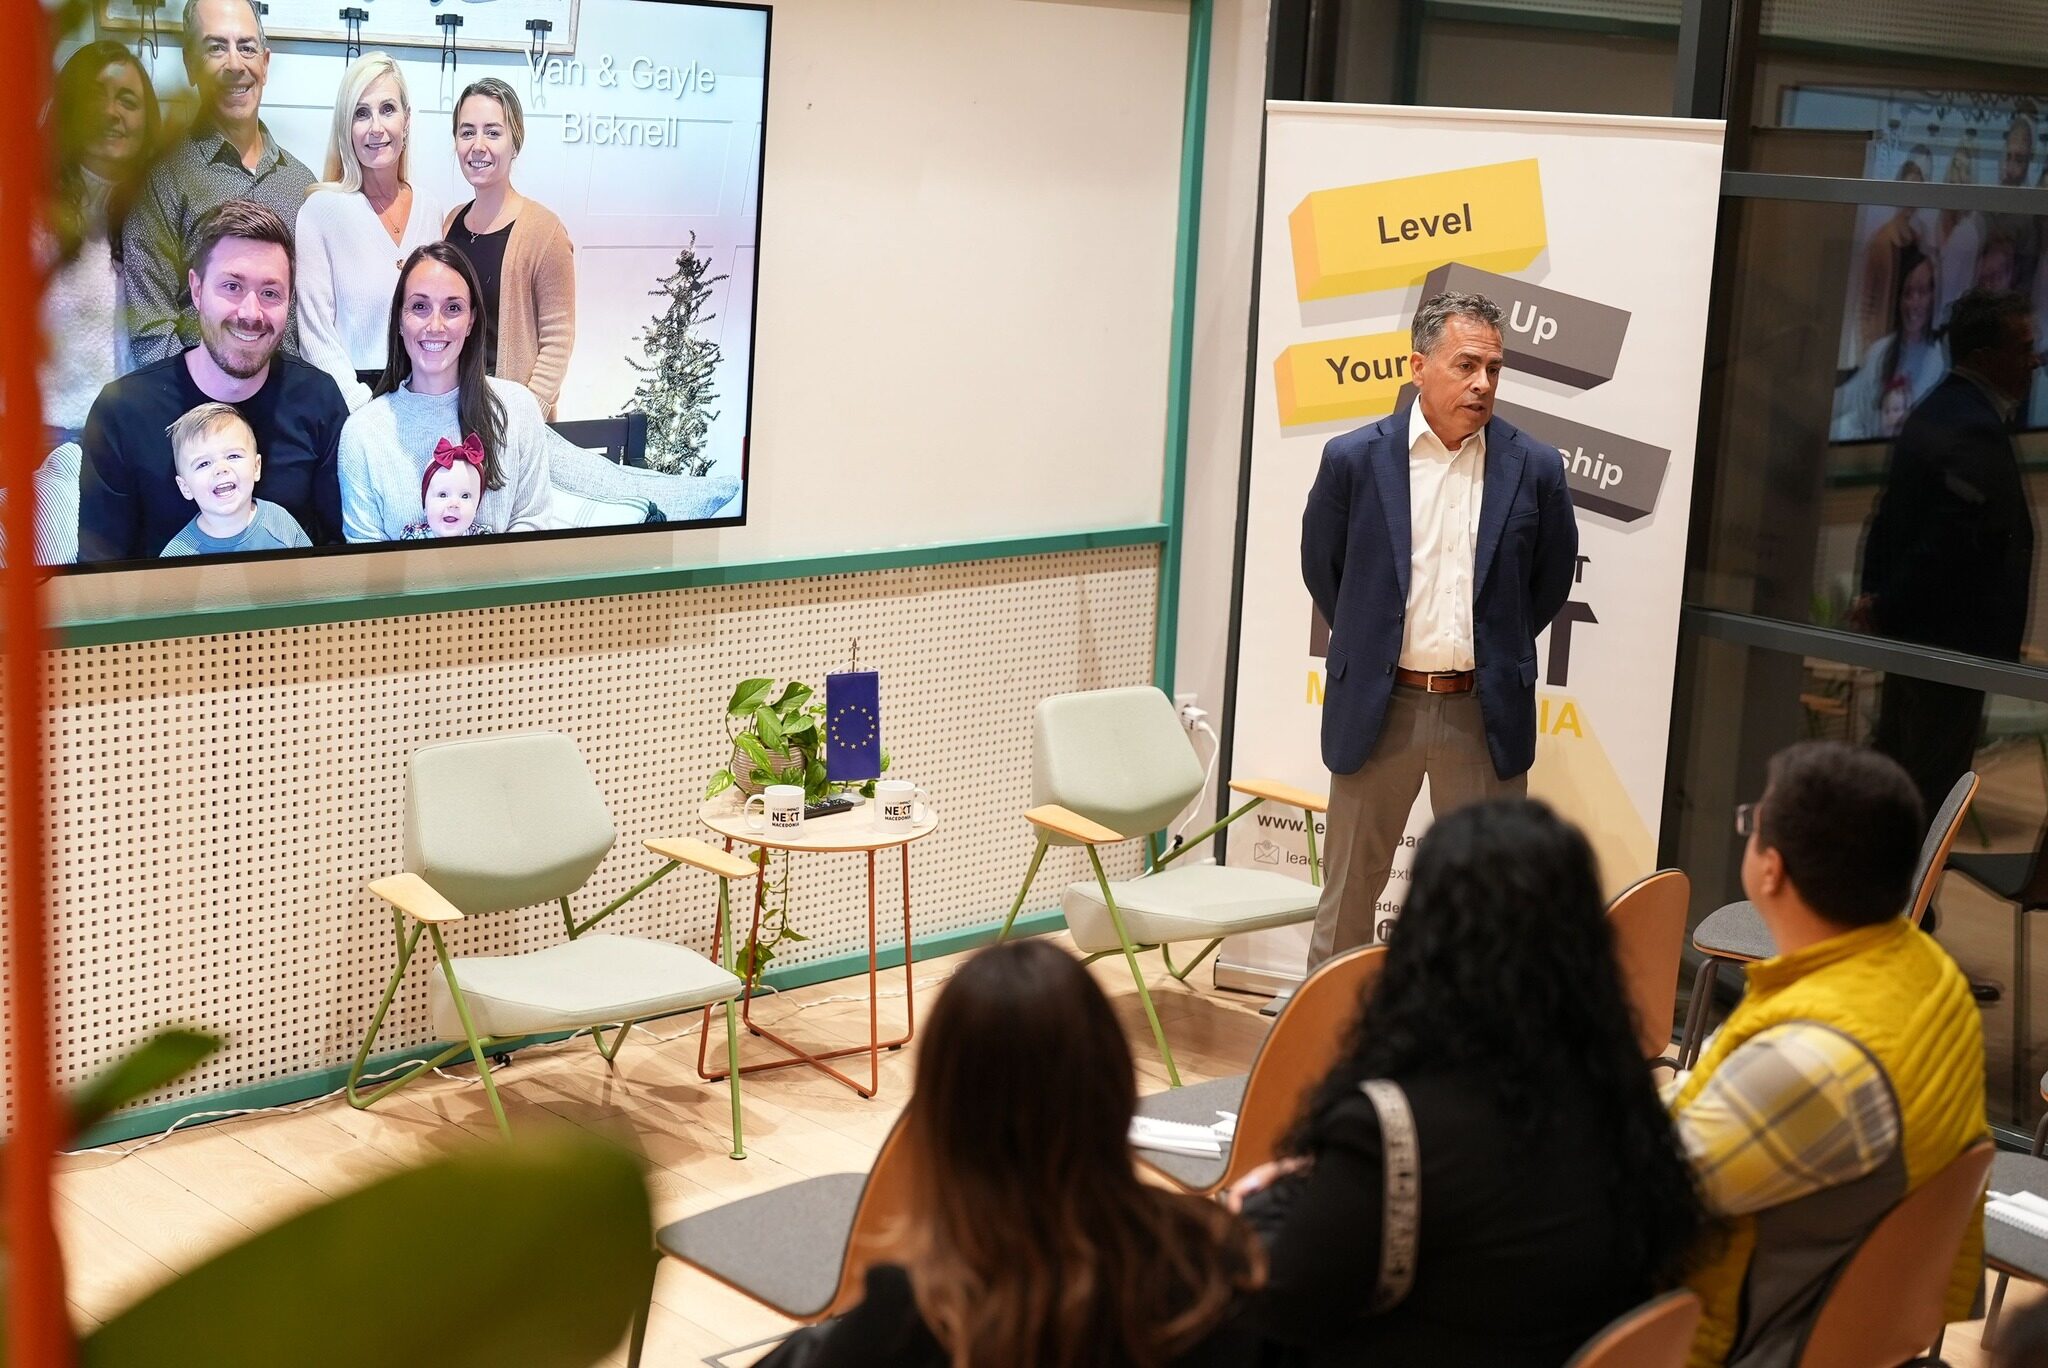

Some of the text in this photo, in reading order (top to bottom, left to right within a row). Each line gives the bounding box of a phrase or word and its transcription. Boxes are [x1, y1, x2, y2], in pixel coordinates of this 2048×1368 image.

[525, 49, 716, 100] Van & Gayle
[561, 113, 679, 147] Bicknell
[1377, 202, 1472, 244] Level
[1509, 300, 1558, 345] Up
[1325, 355, 1408, 385] Your
[772, 811, 800, 822] NEXT
[884, 804, 912, 816] NEXT
